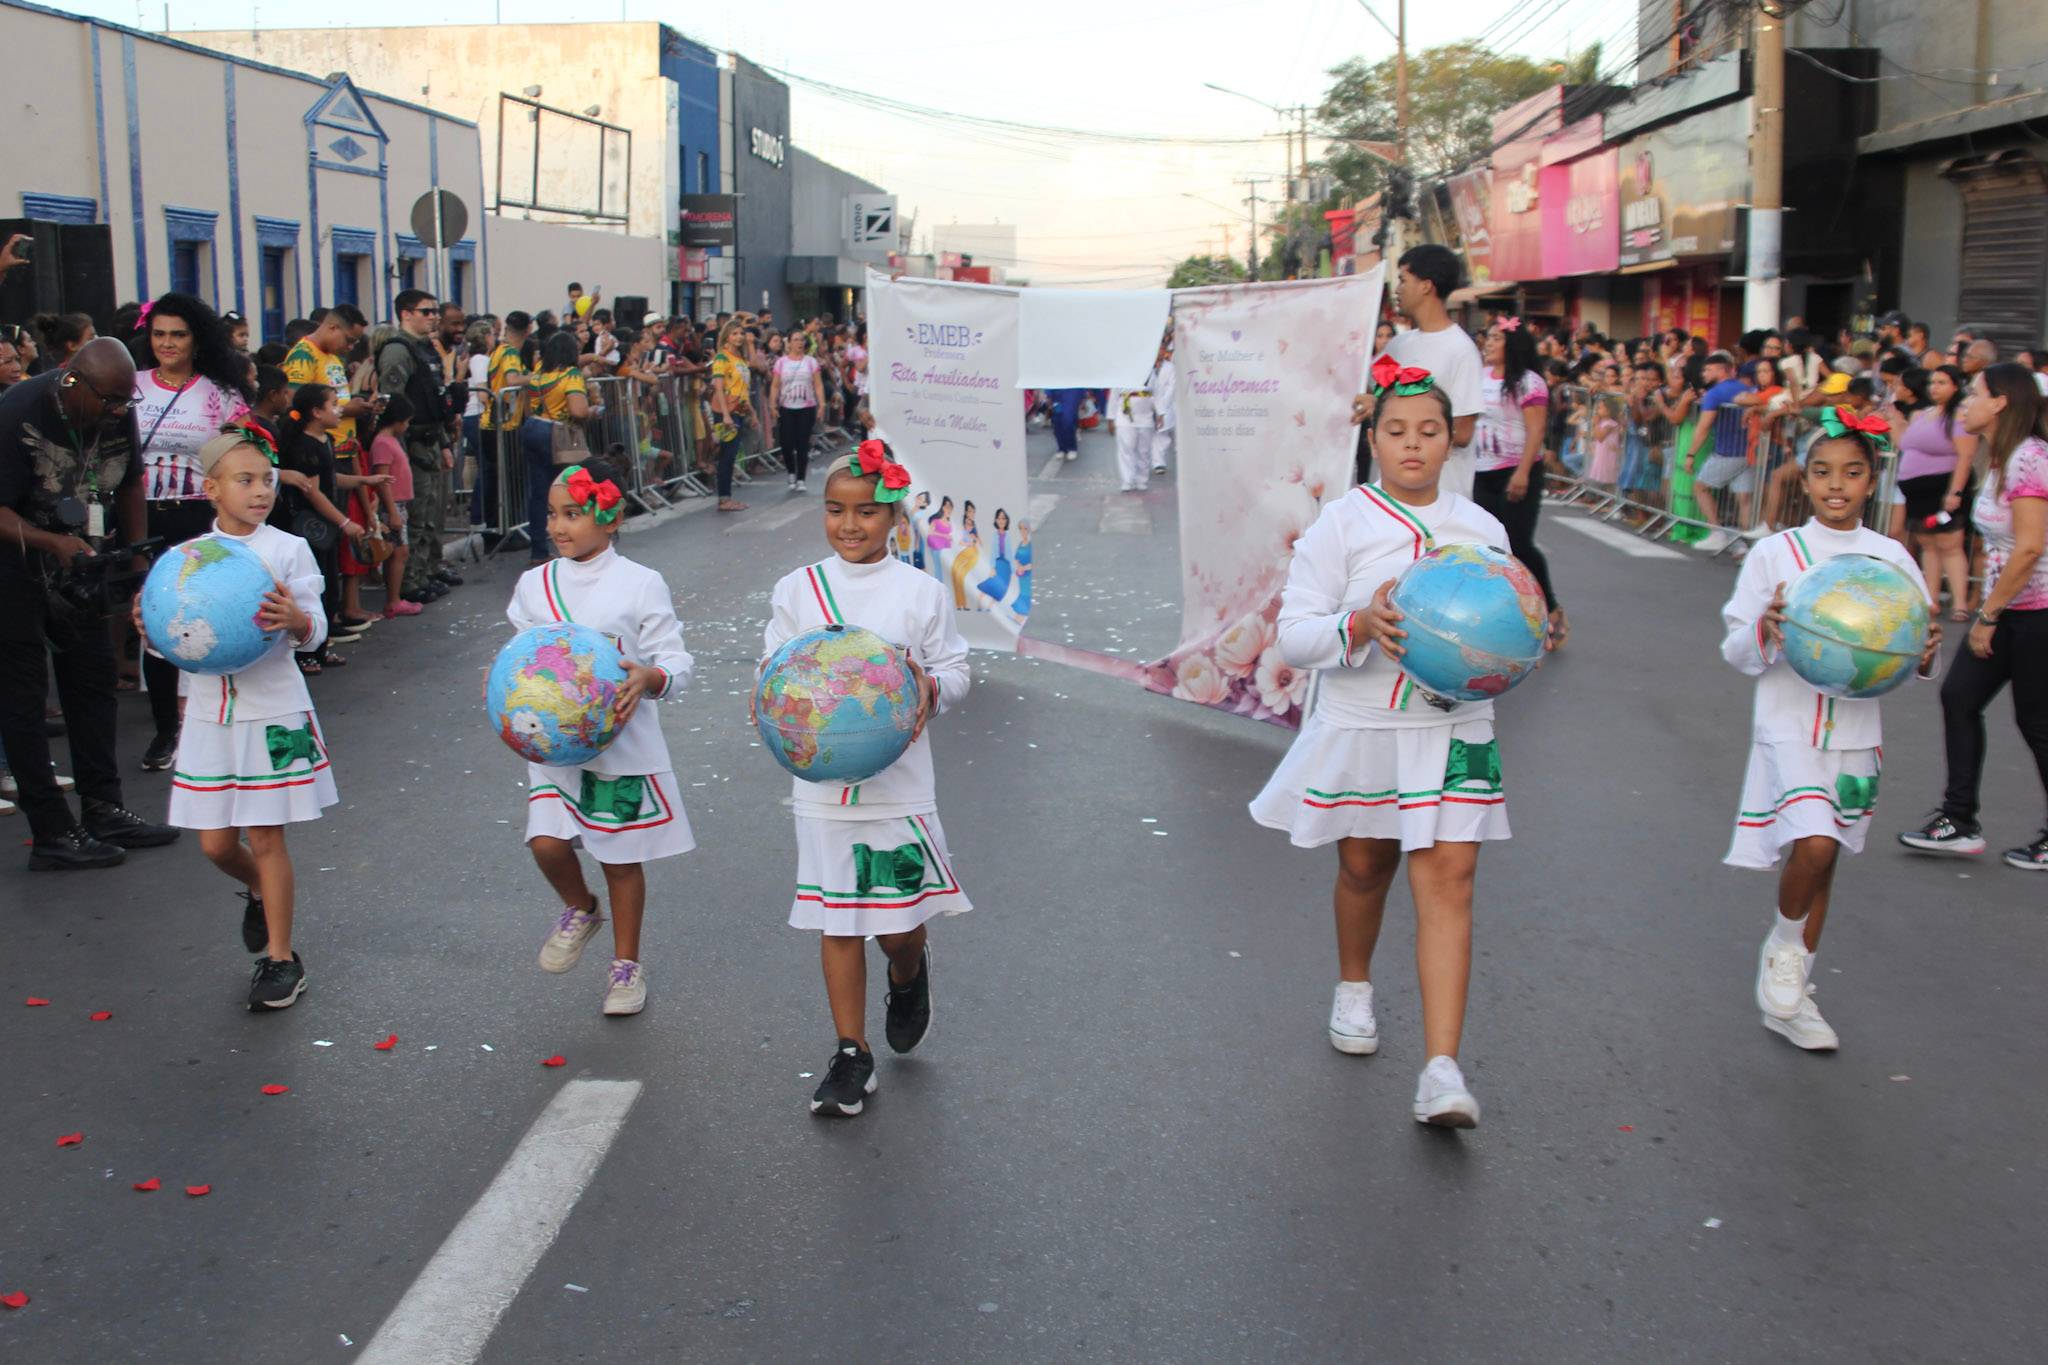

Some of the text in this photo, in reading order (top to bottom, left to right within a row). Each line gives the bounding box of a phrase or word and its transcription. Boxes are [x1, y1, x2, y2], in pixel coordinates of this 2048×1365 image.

[751, 126, 777, 164] STUDIO
[854, 203, 862, 242] STUDIO
[918, 323, 971, 348] EMEB
[1199, 350, 1214, 362] Ser
[1217, 350, 1256, 361] Mulher
[890, 362, 1000, 389] Rita Auxiliadora
[1186, 370, 1280, 401] Transformar
[147, 404, 179, 415] EMB
[141, 418, 206, 432] Axiliadora
[948, 414, 989, 432] Mulher
[1221, 427, 1233, 437] os
[1235, 424, 1256, 437] dias
